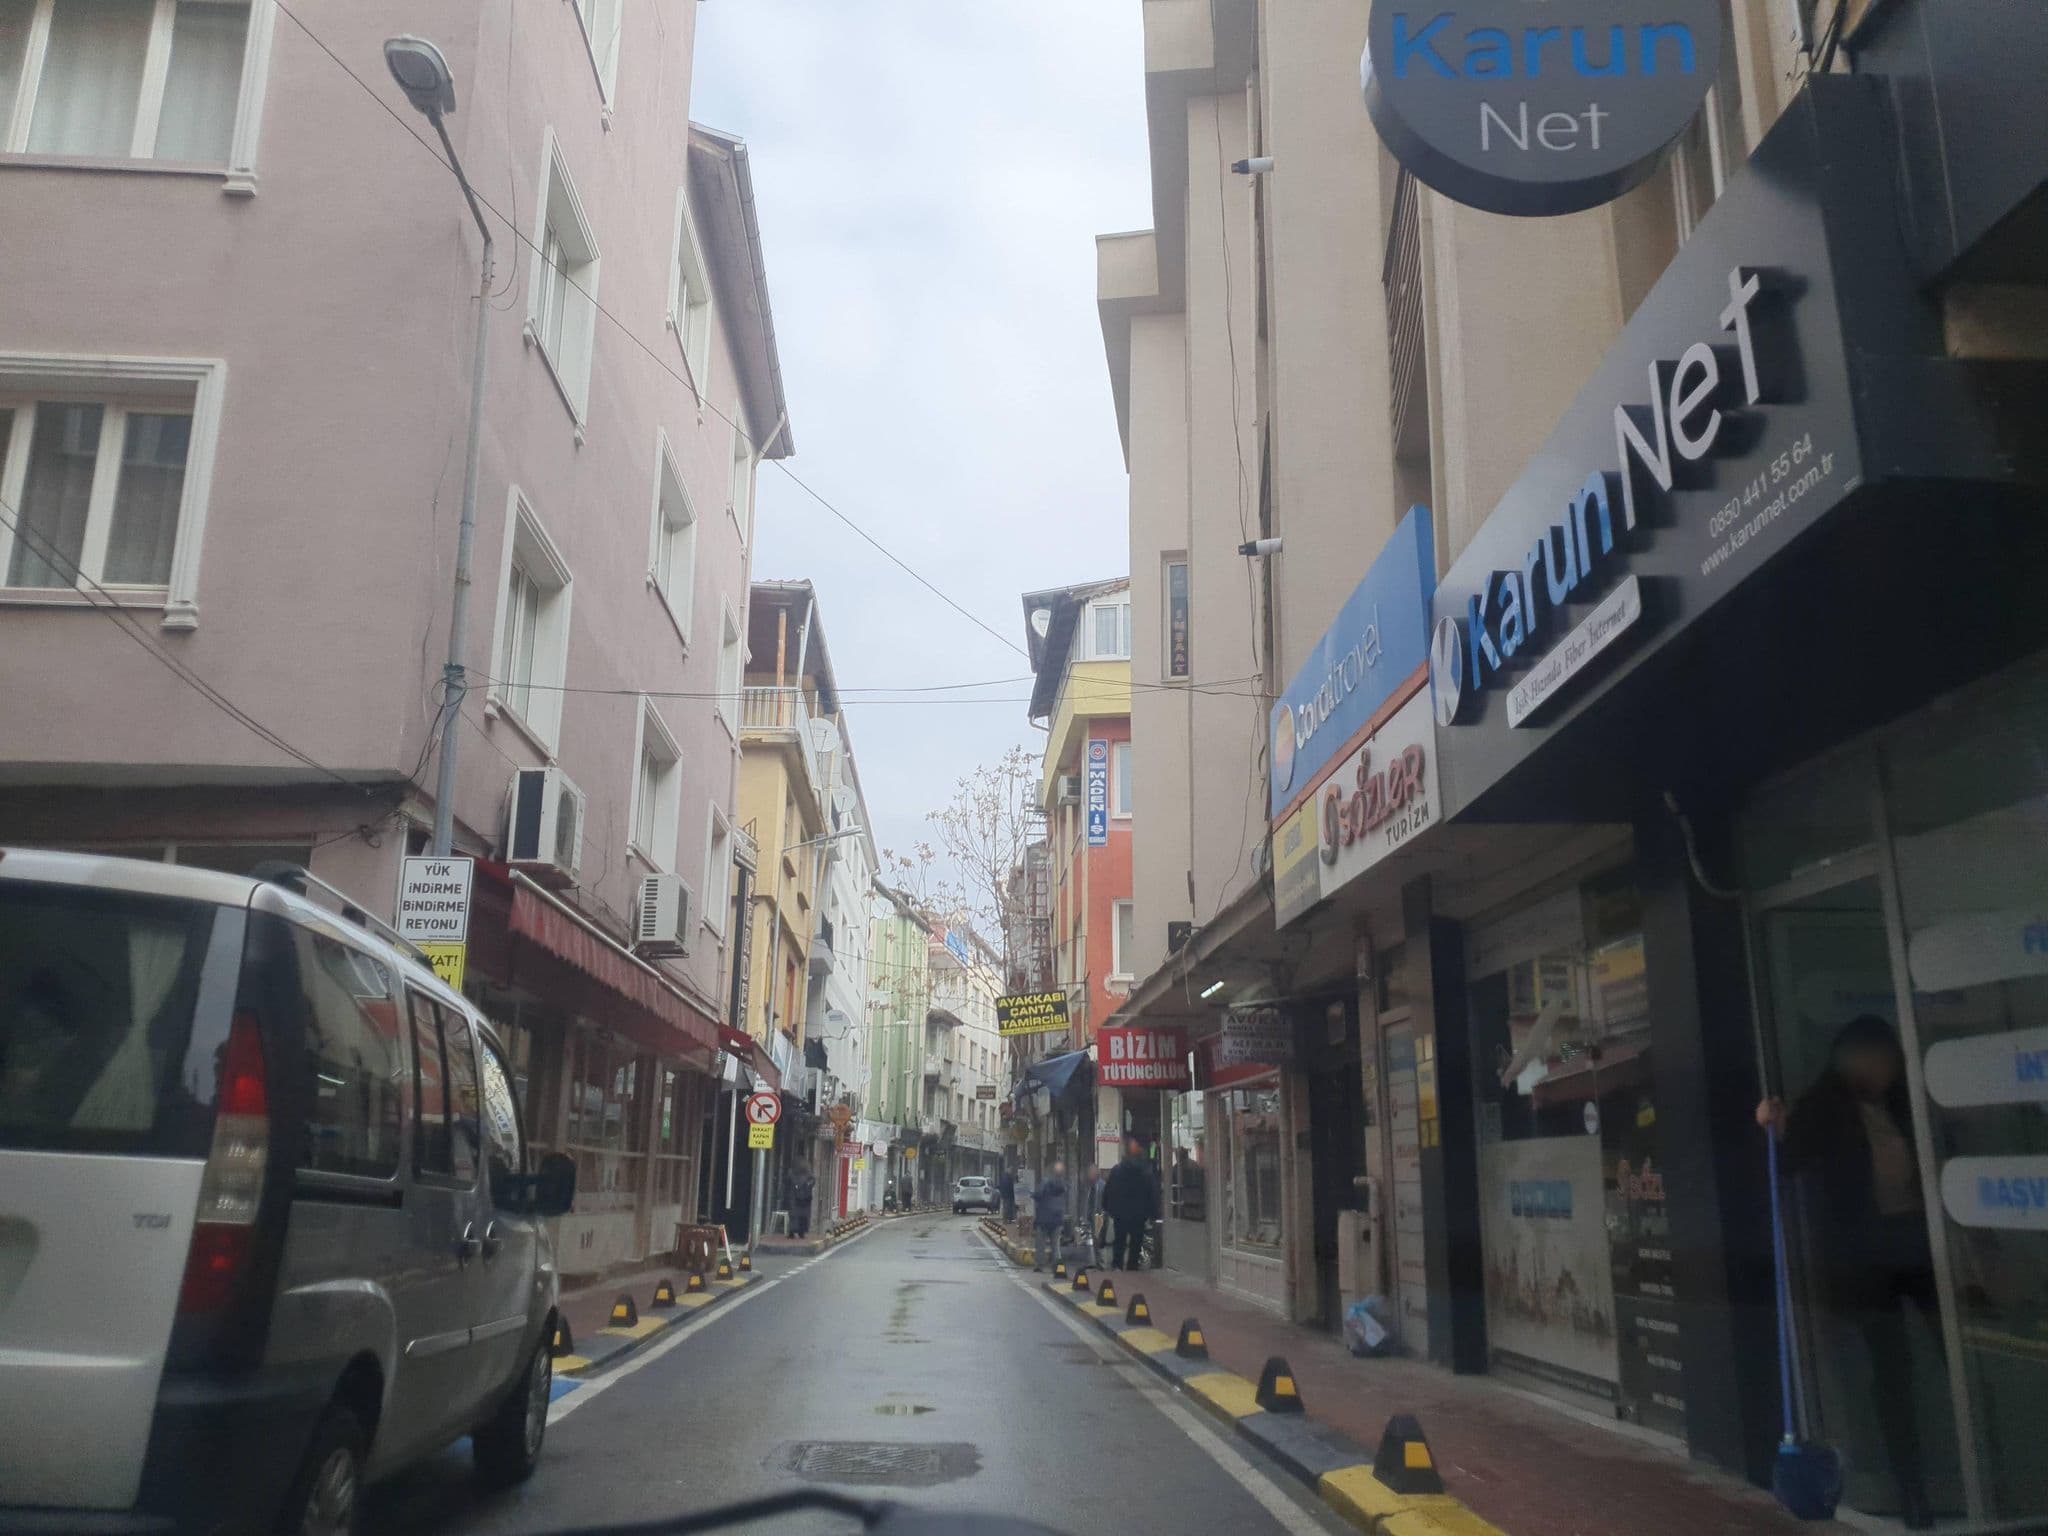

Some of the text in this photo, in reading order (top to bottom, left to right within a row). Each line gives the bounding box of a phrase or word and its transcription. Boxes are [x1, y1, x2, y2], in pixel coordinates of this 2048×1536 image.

[1391, 12, 1697, 81] Karun
[1480, 99, 1611, 152] Net
[1709, 432, 1813, 539] 0850 441 55 64
[1700, 452, 1834, 576] www.karunnet.com.tr
[1564, 639, 1586, 670] Fiber
[1089, 771, 1106, 812] MADEN
[1385, 801, 1430, 846] TURİZM
[425, 862, 451, 876] YÜK
[406, 918, 458, 930] REYONU
[998, 992, 1065, 1008] AYAKKABI
[1010, 1004, 1055, 1018] ÇANTA
[1109, 1031, 1176, 1060] BİZİM
[1102, 1061, 1187, 1081] TÜTÜNCÜLÜK
